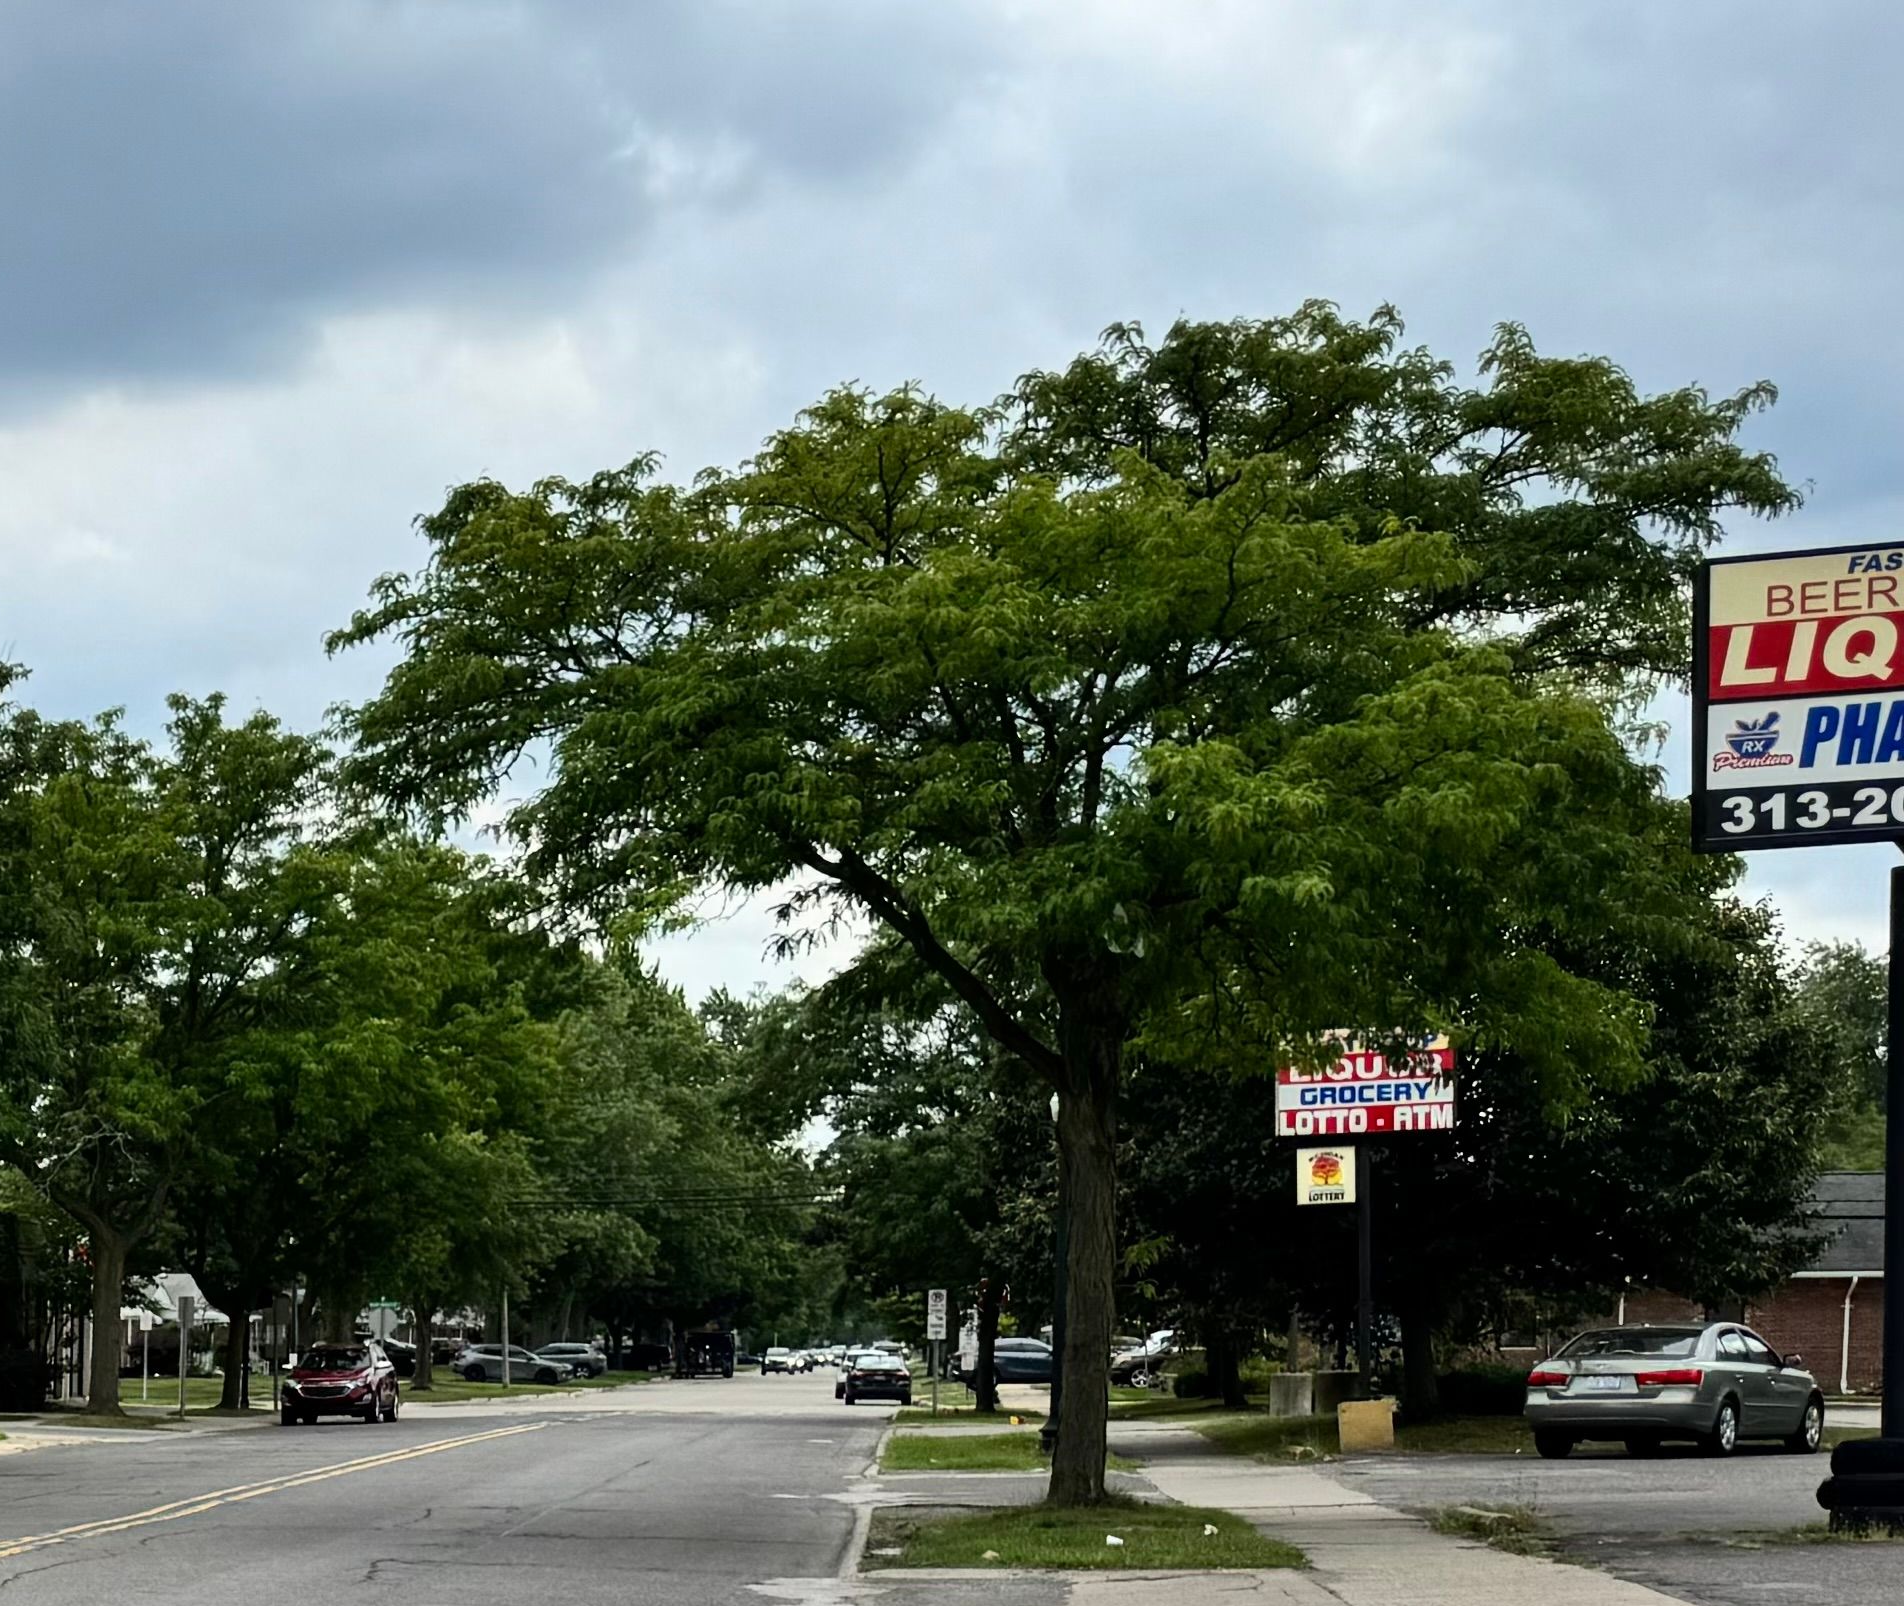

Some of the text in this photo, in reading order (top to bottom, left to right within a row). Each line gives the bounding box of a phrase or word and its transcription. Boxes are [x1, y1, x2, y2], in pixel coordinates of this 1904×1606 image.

[1847, 552, 1904, 574] FAS
[1766, 576, 1900, 617] BEER
[1720, 615, 1899, 687] LIQ
[1742, 739, 1766, 753] RX
[1713, 752, 1794, 772] Premium
[1300, 1081, 1431, 1106] GROCERY
[1279, 1103, 1454, 1136] LOTTO ATM
